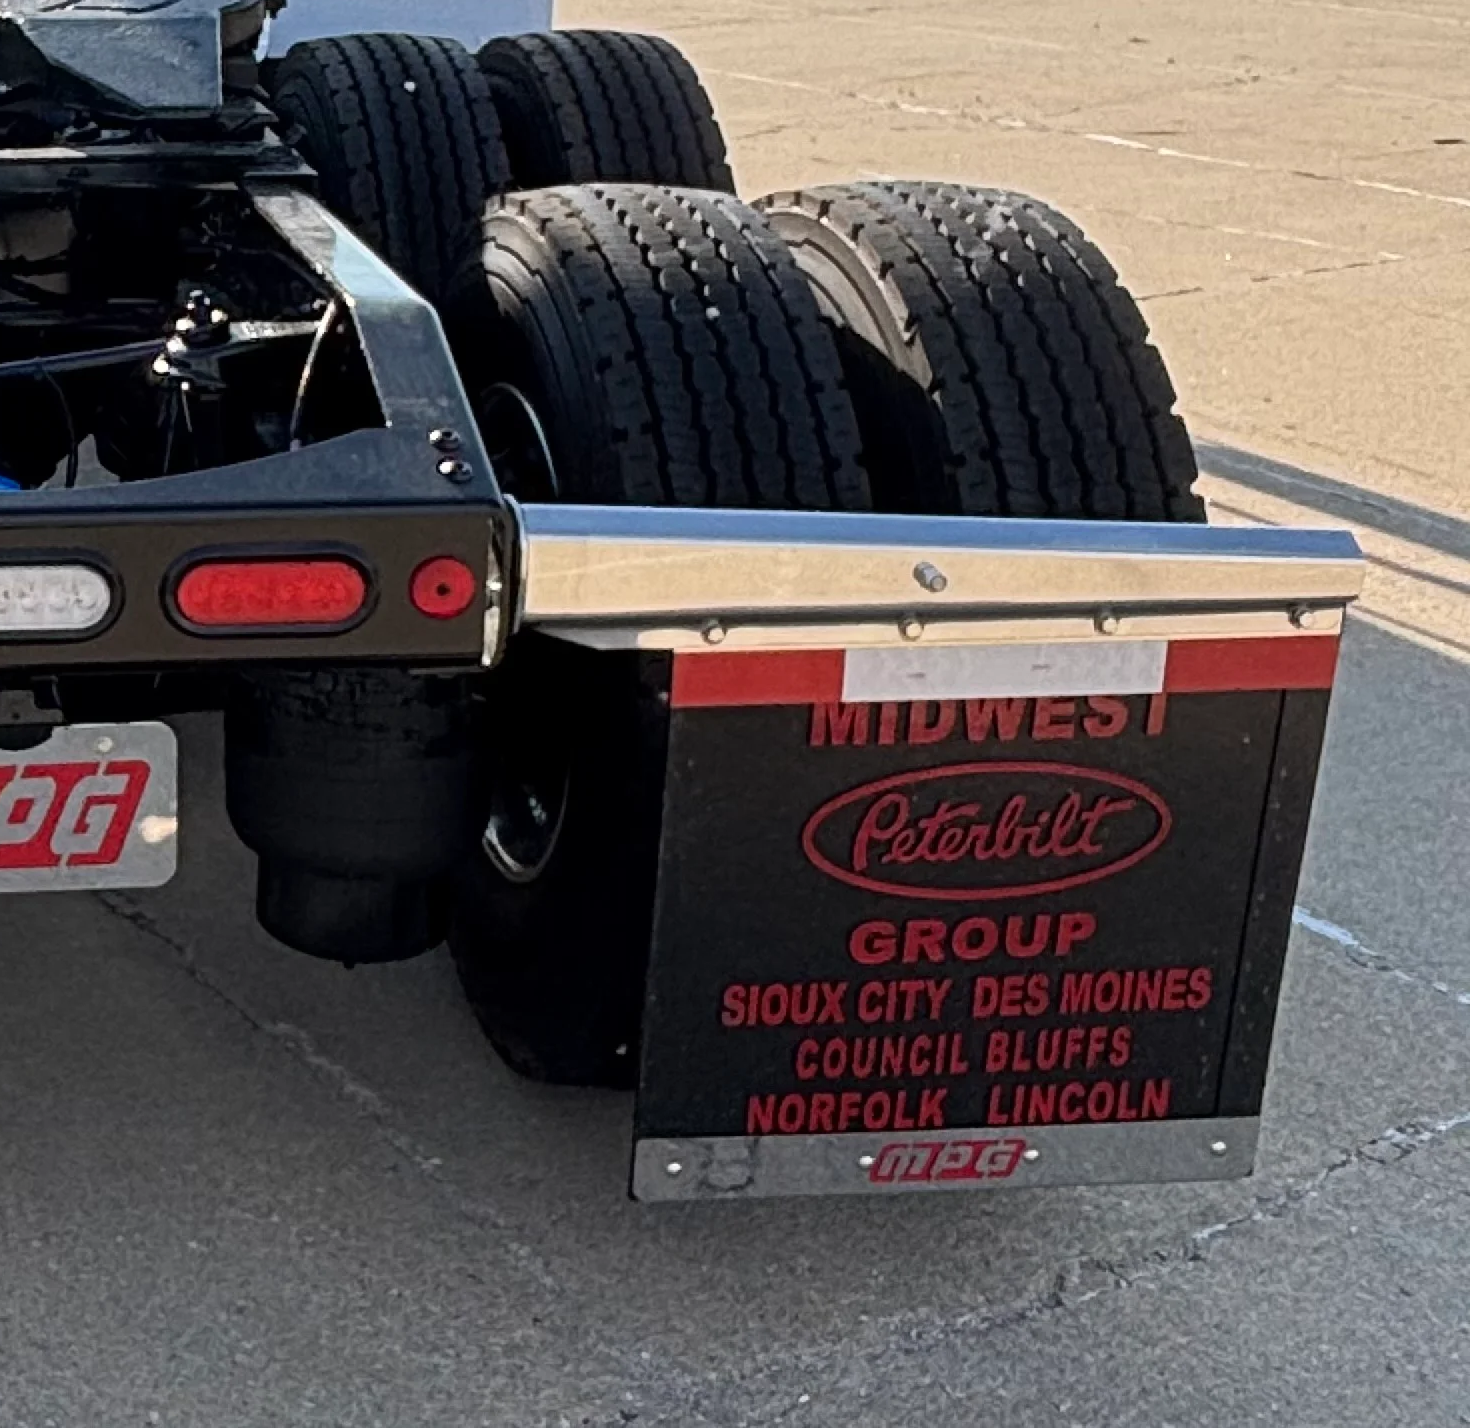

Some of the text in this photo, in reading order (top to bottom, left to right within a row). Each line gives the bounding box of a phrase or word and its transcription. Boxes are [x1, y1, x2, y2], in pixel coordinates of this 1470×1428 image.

[852, 788, 1137, 872] Peterbilt
[849, 911, 1097, 965] GROUP
[721, 967, 1213, 1027] SIOUX CITY DES MOINES
[795, 1026, 1132, 1080] COUNCIL BLUFFS
[746, 1078, 1172, 1134] NORFOLK LINCOLN
[873, 1140, 1022, 1181] MPG
